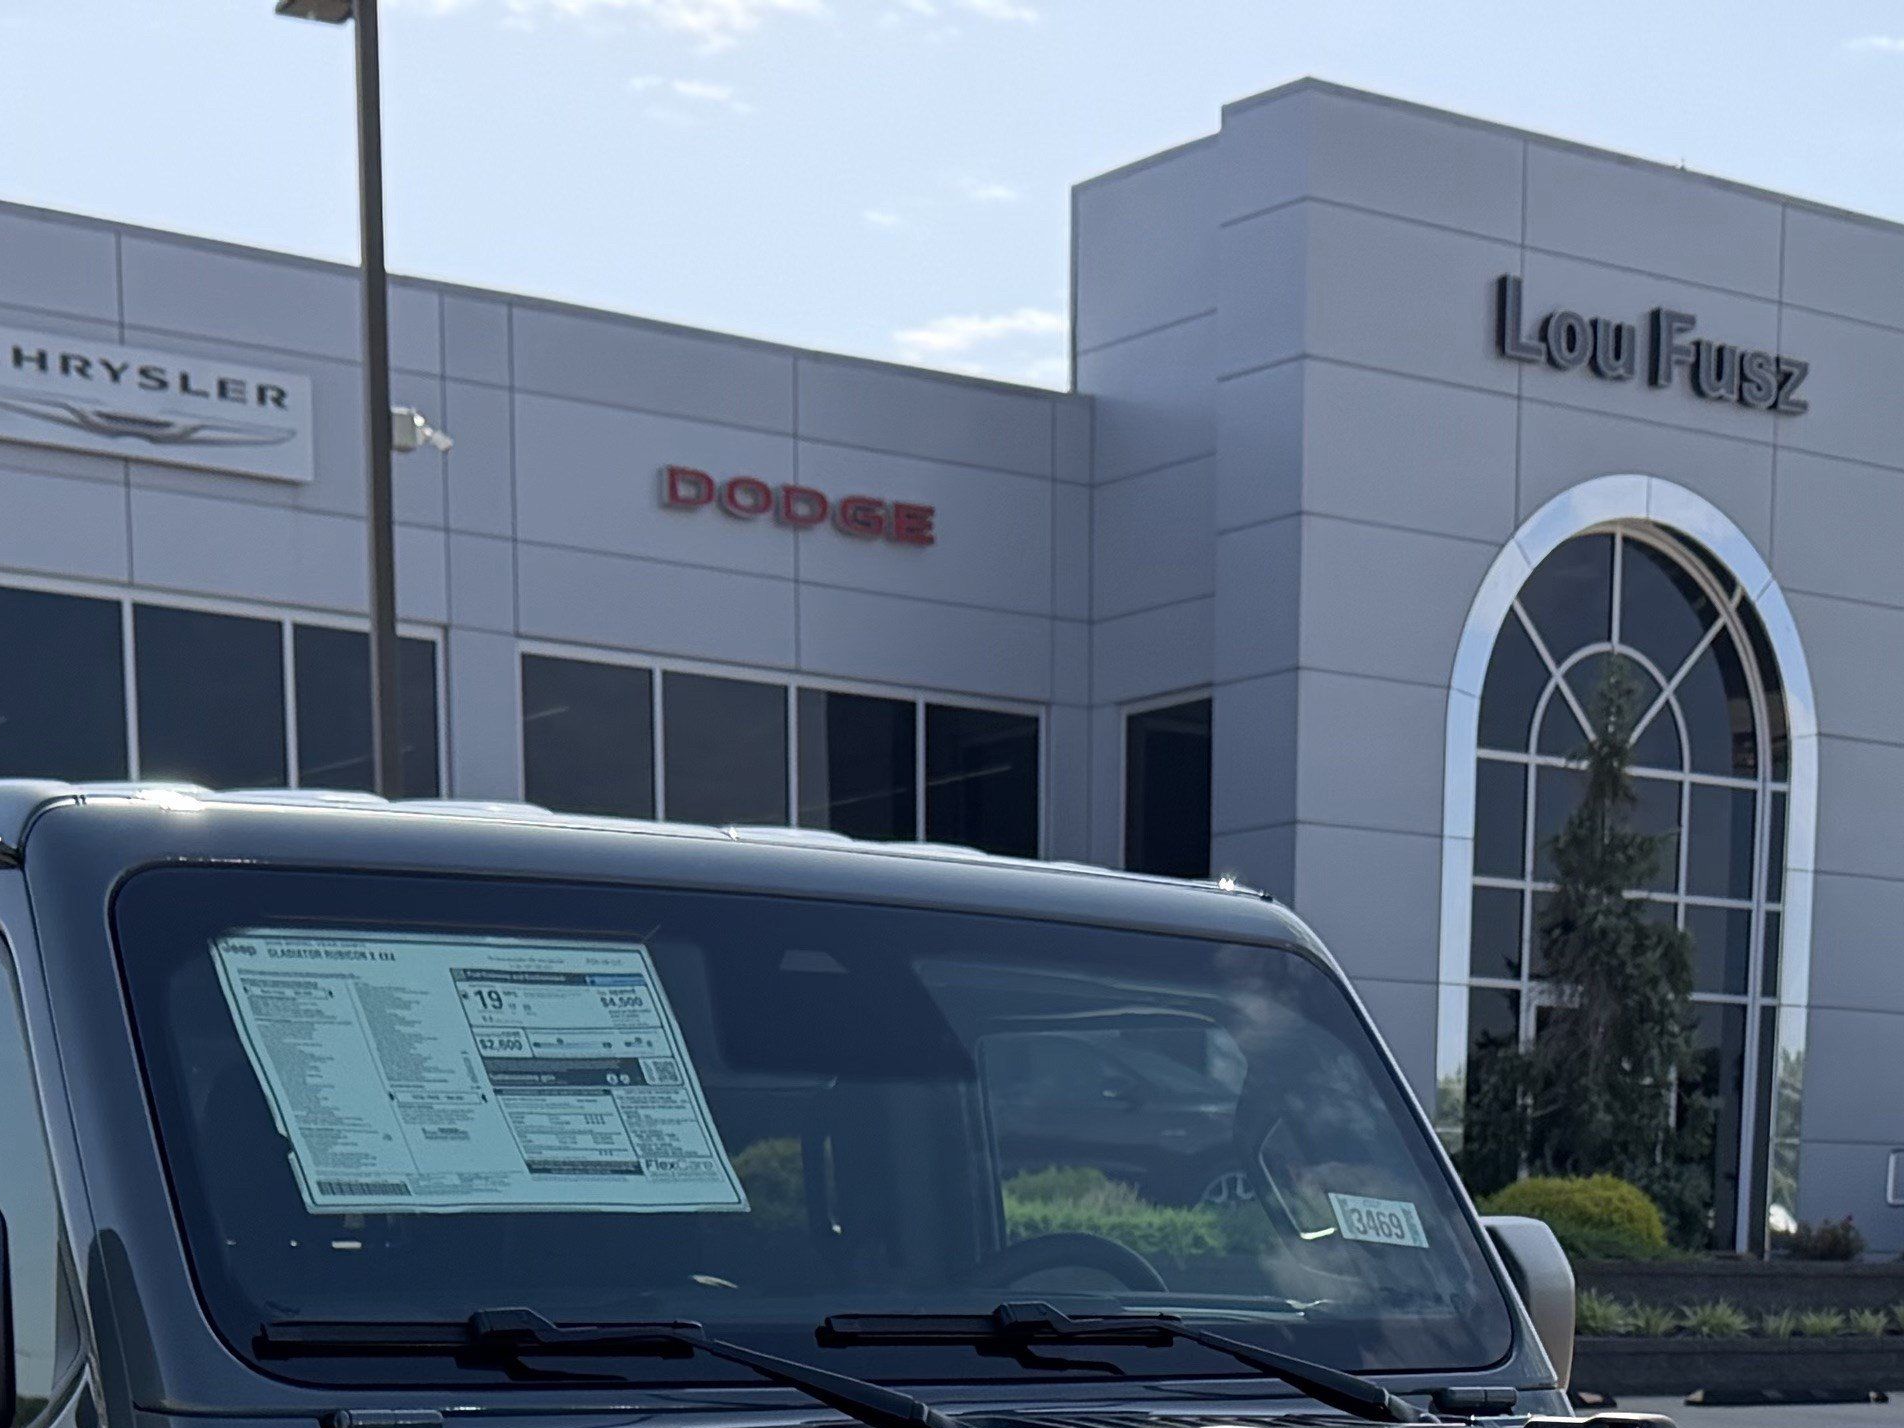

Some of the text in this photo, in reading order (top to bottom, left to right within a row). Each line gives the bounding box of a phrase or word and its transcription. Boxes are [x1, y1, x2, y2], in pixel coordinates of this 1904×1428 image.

[1495, 272, 1809, 415] Lou Fusz
[658, 465, 936, 548] DODGE
[474, 989, 504, 1010] 19
[1351, 1208, 1404, 1239] 3469
